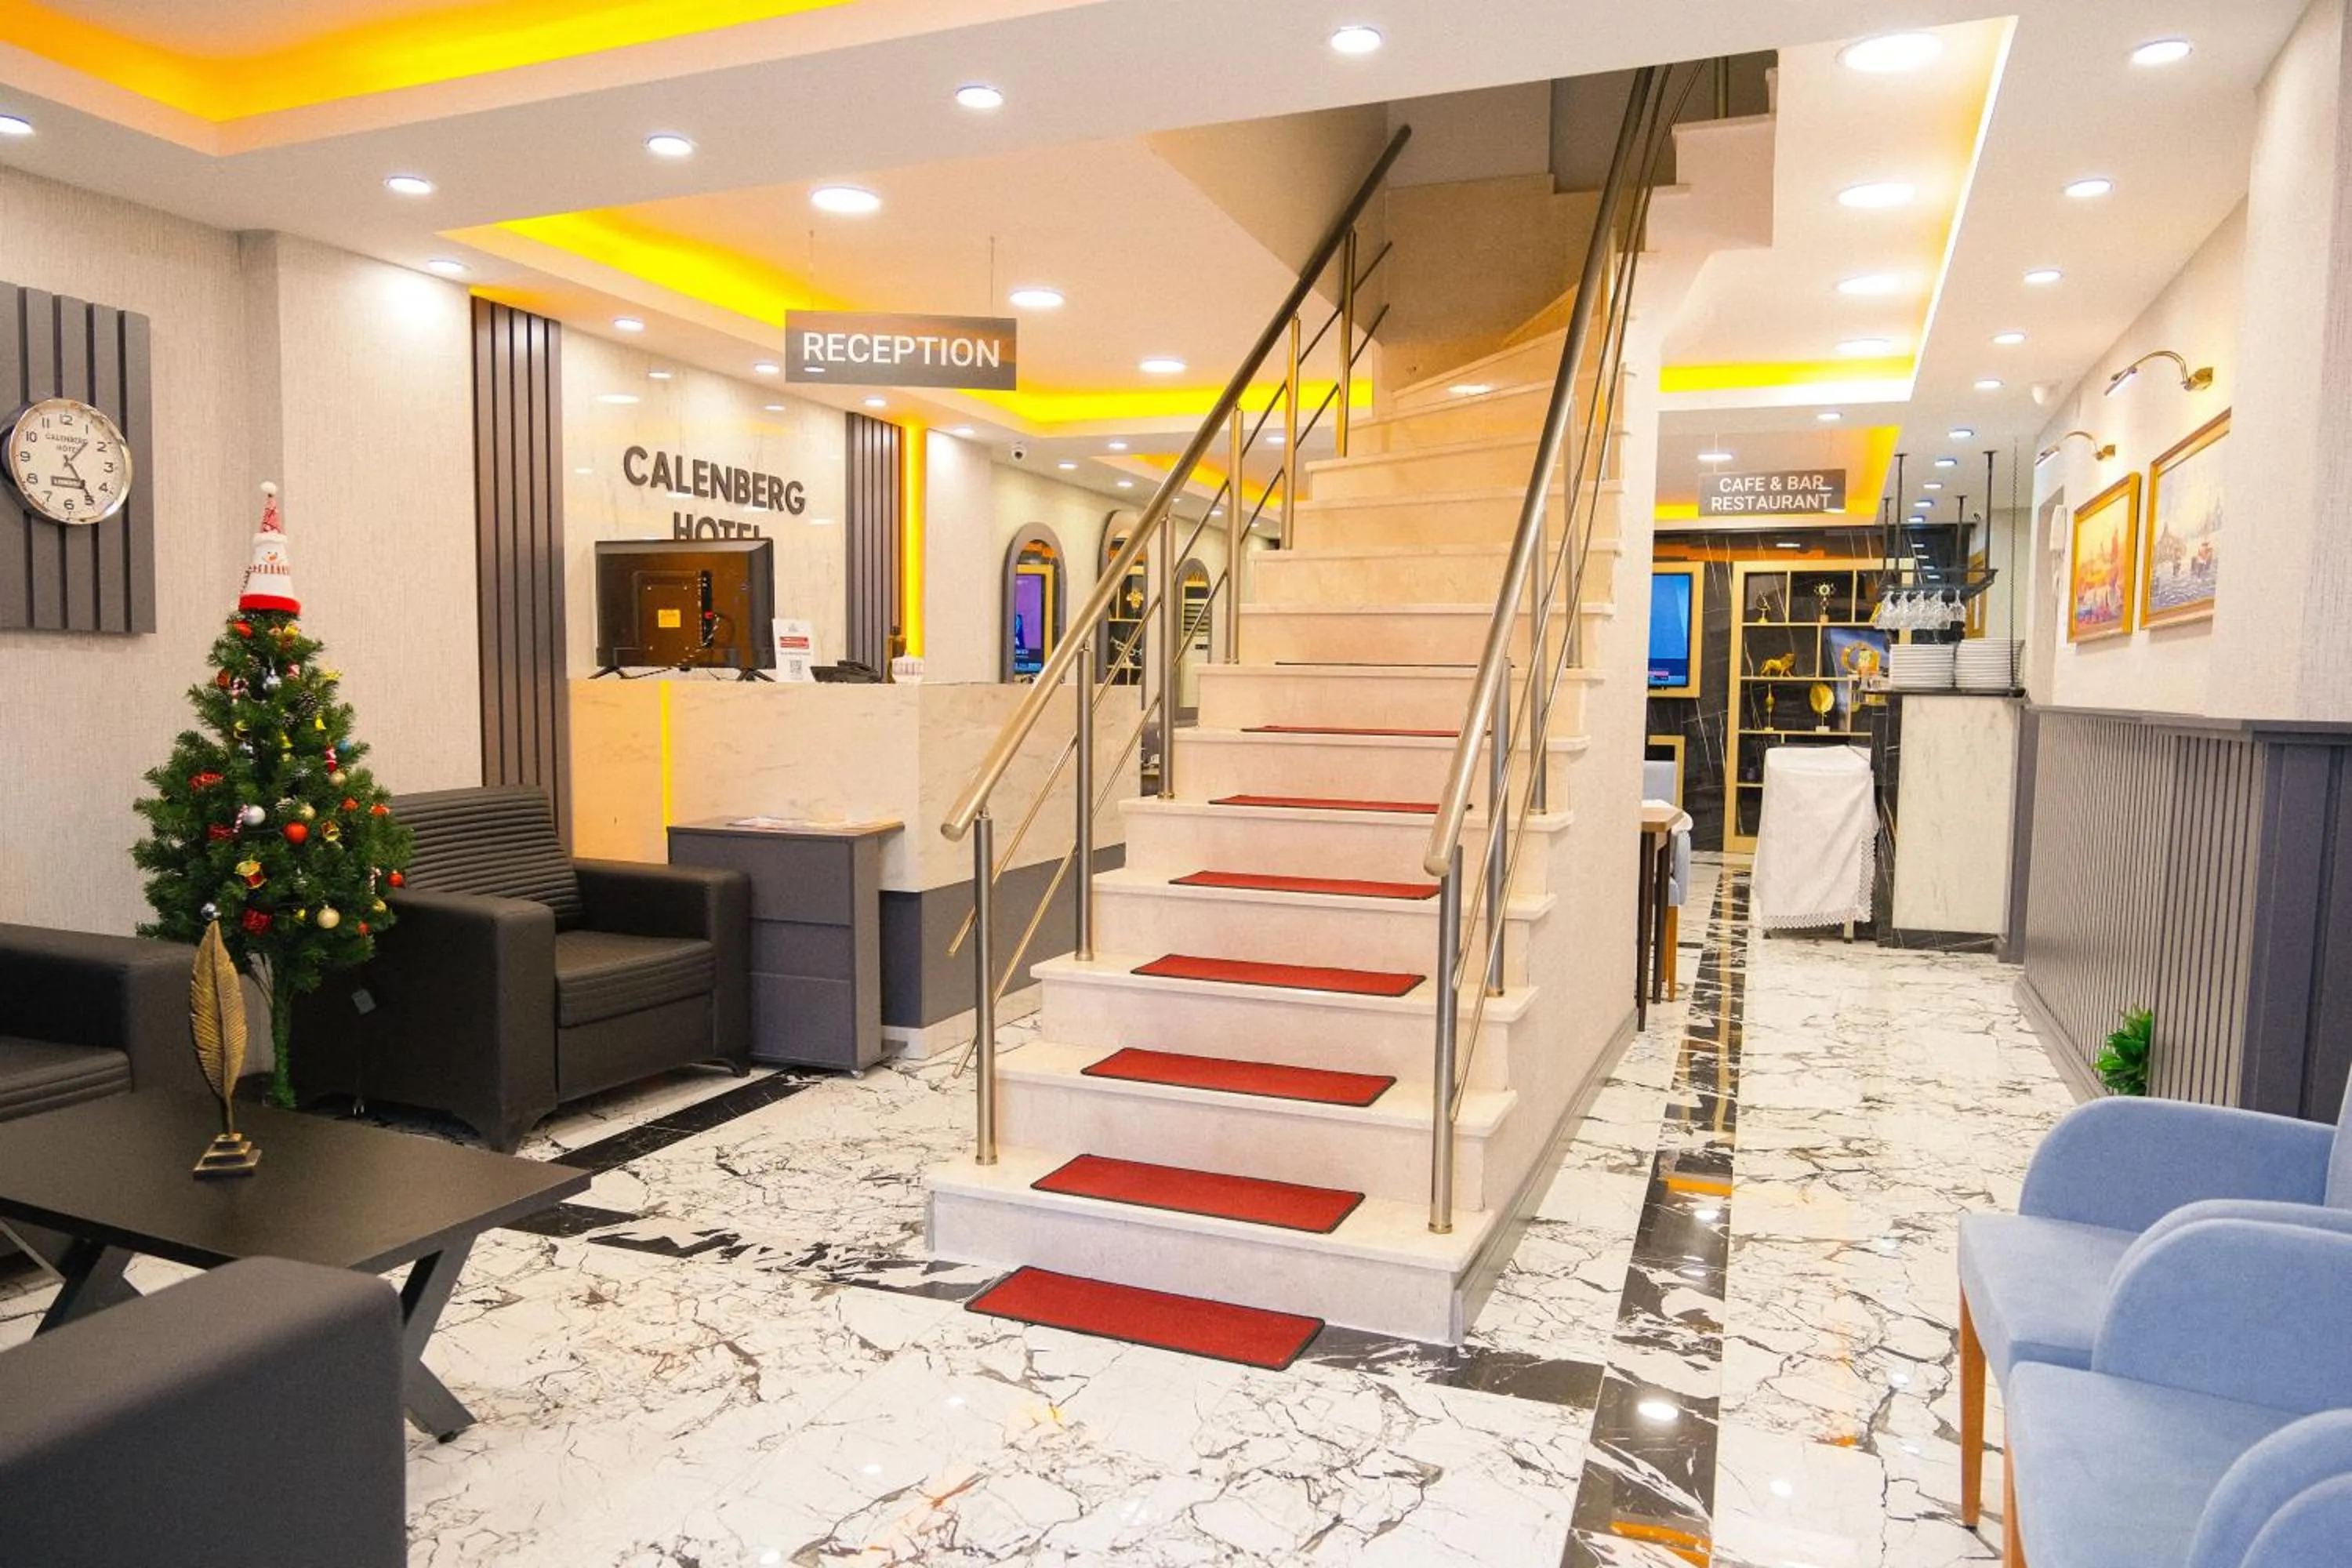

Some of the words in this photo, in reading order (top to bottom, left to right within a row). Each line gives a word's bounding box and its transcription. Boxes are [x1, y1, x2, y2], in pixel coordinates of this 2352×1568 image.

[803, 332, 1000, 368] RECEPTION
[42, 417, 49, 429] 11
[60, 413, 73, 426] 12
[26, 430, 37, 443] 10
[96, 441, 107, 452] 2
[20, 450, 31, 463] 9
[103, 461, 114, 474] 3
[27, 473, 38, 485] 8
[623, 445, 805, 514] CALENBERG
[1719, 477, 1766, 492] CAFE
[1769, 477, 1782, 491] &
[1787, 475, 1824, 490] BAR
[99, 482, 108, 493] 4
[43, 491, 53, 503] 7
[84, 494, 95, 506] 5
[1711, 493, 1832, 511] RESTAURANT
[64, 499, 74, 510] 6
